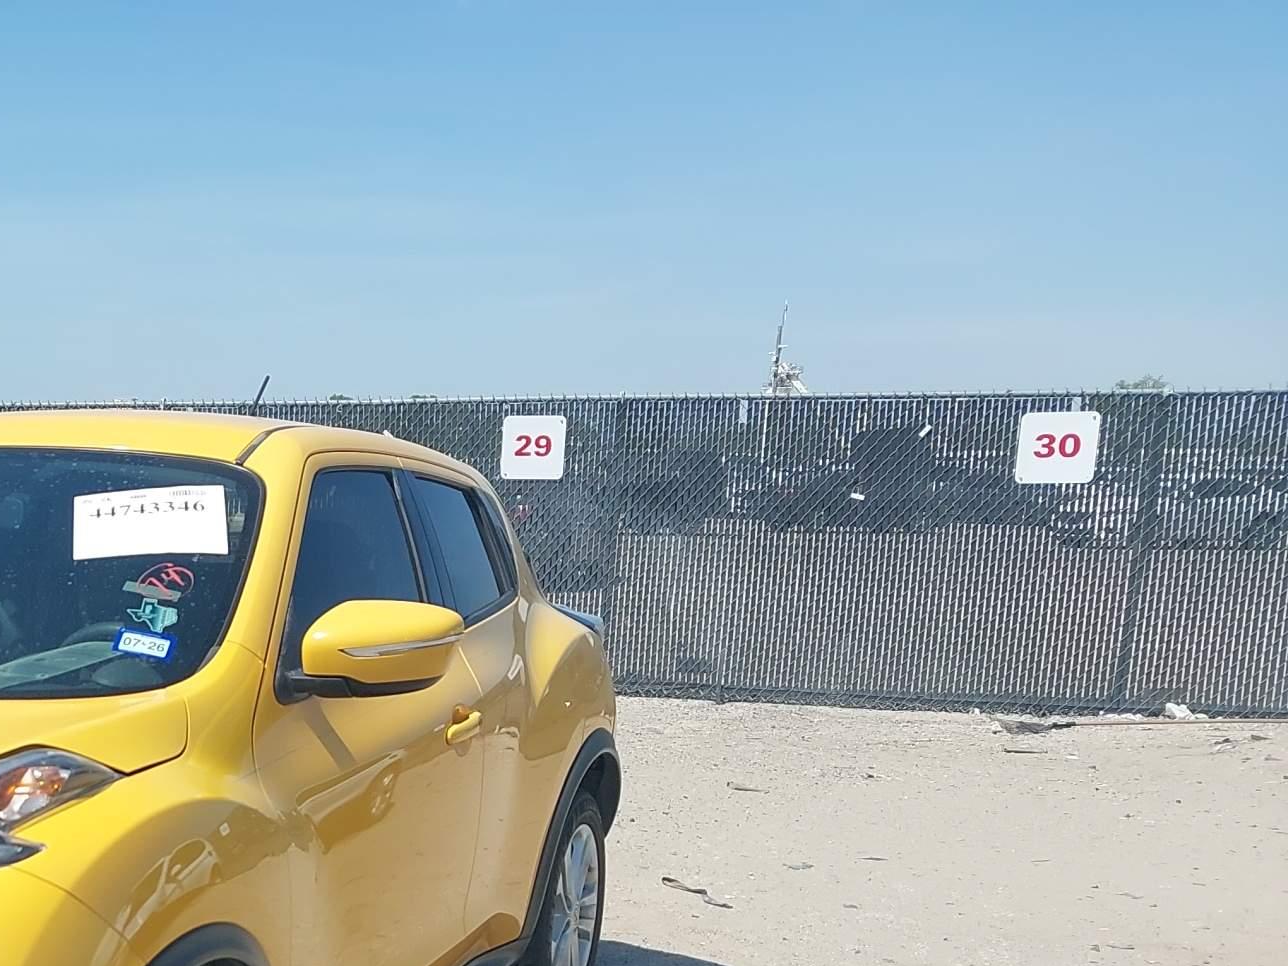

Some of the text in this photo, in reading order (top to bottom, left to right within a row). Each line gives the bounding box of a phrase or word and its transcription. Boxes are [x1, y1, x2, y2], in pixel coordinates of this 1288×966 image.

[514, 435, 552, 457] 29
[1033, 433, 1081, 458] 30
[88, 499, 206, 519] 44743346
[123, 636, 166, 653] 07-26
